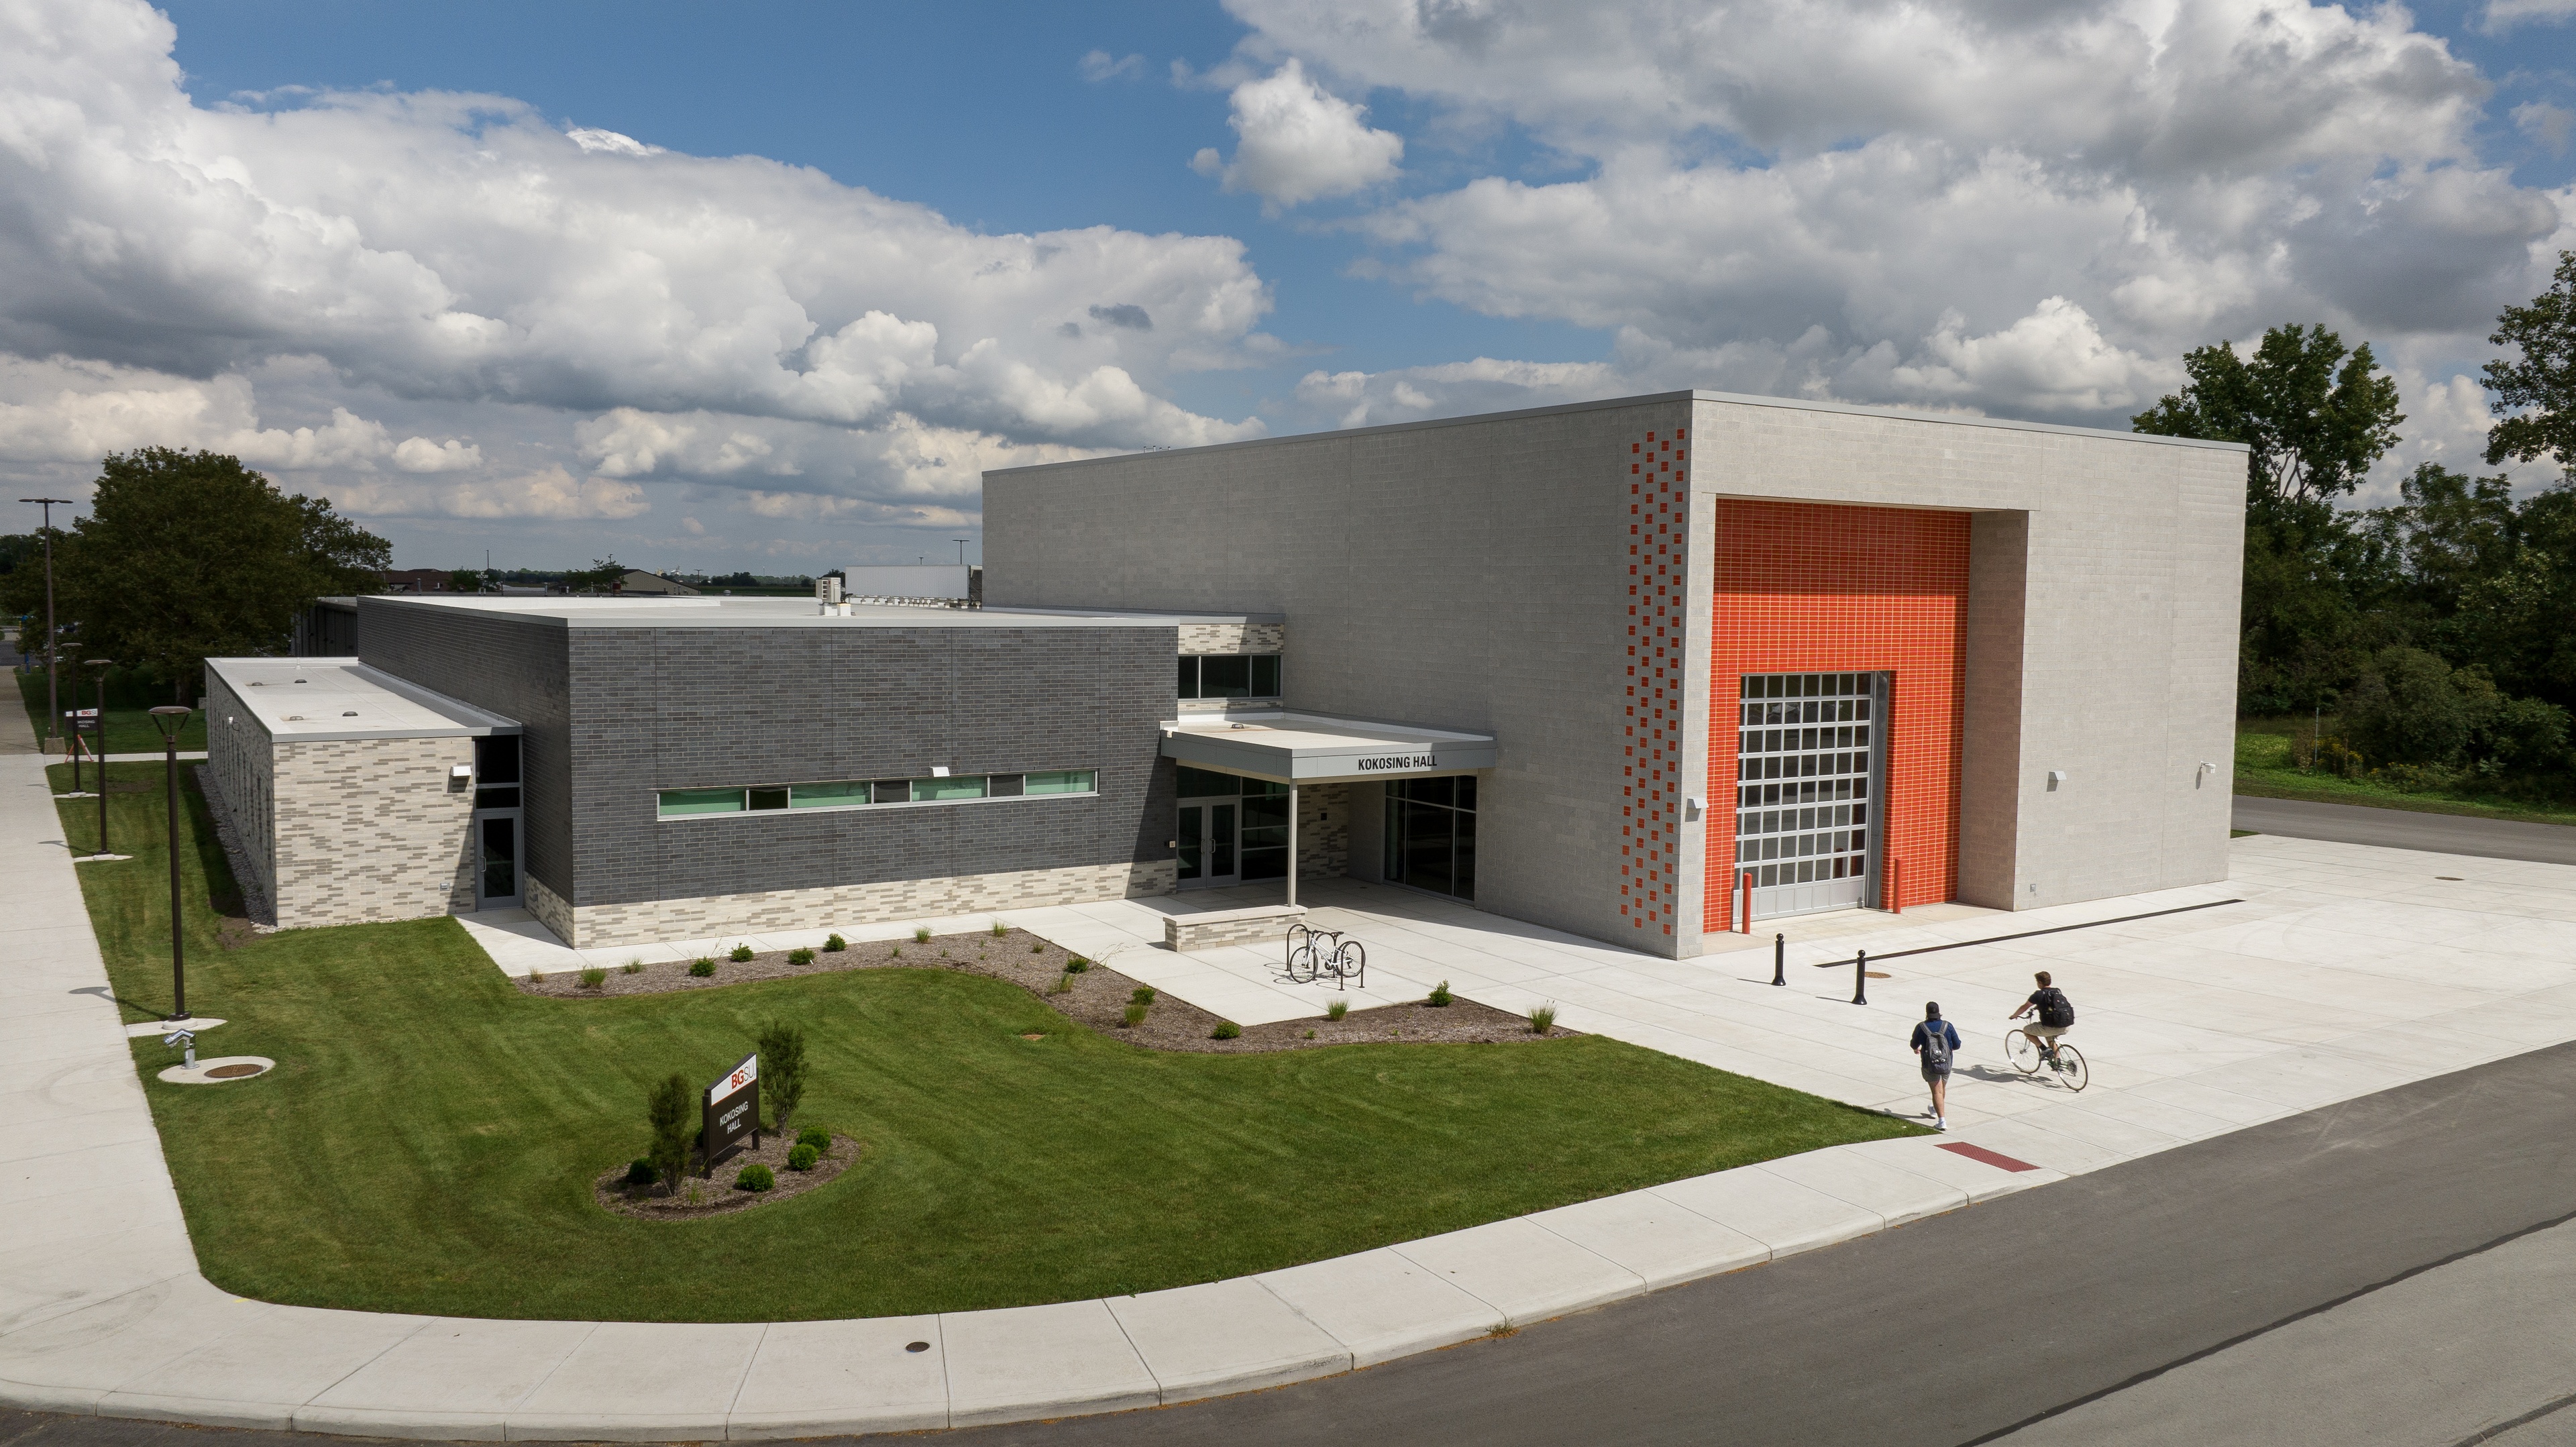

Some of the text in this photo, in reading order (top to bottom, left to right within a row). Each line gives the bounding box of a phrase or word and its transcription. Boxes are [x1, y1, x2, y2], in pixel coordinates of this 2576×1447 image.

[1358, 755, 1438, 771] KOKOSING HALL
[731, 1062, 754, 1089] BGSU
[719, 1101, 749, 1127] KOKOSING
[727, 1118, 742, 1134] HALL
